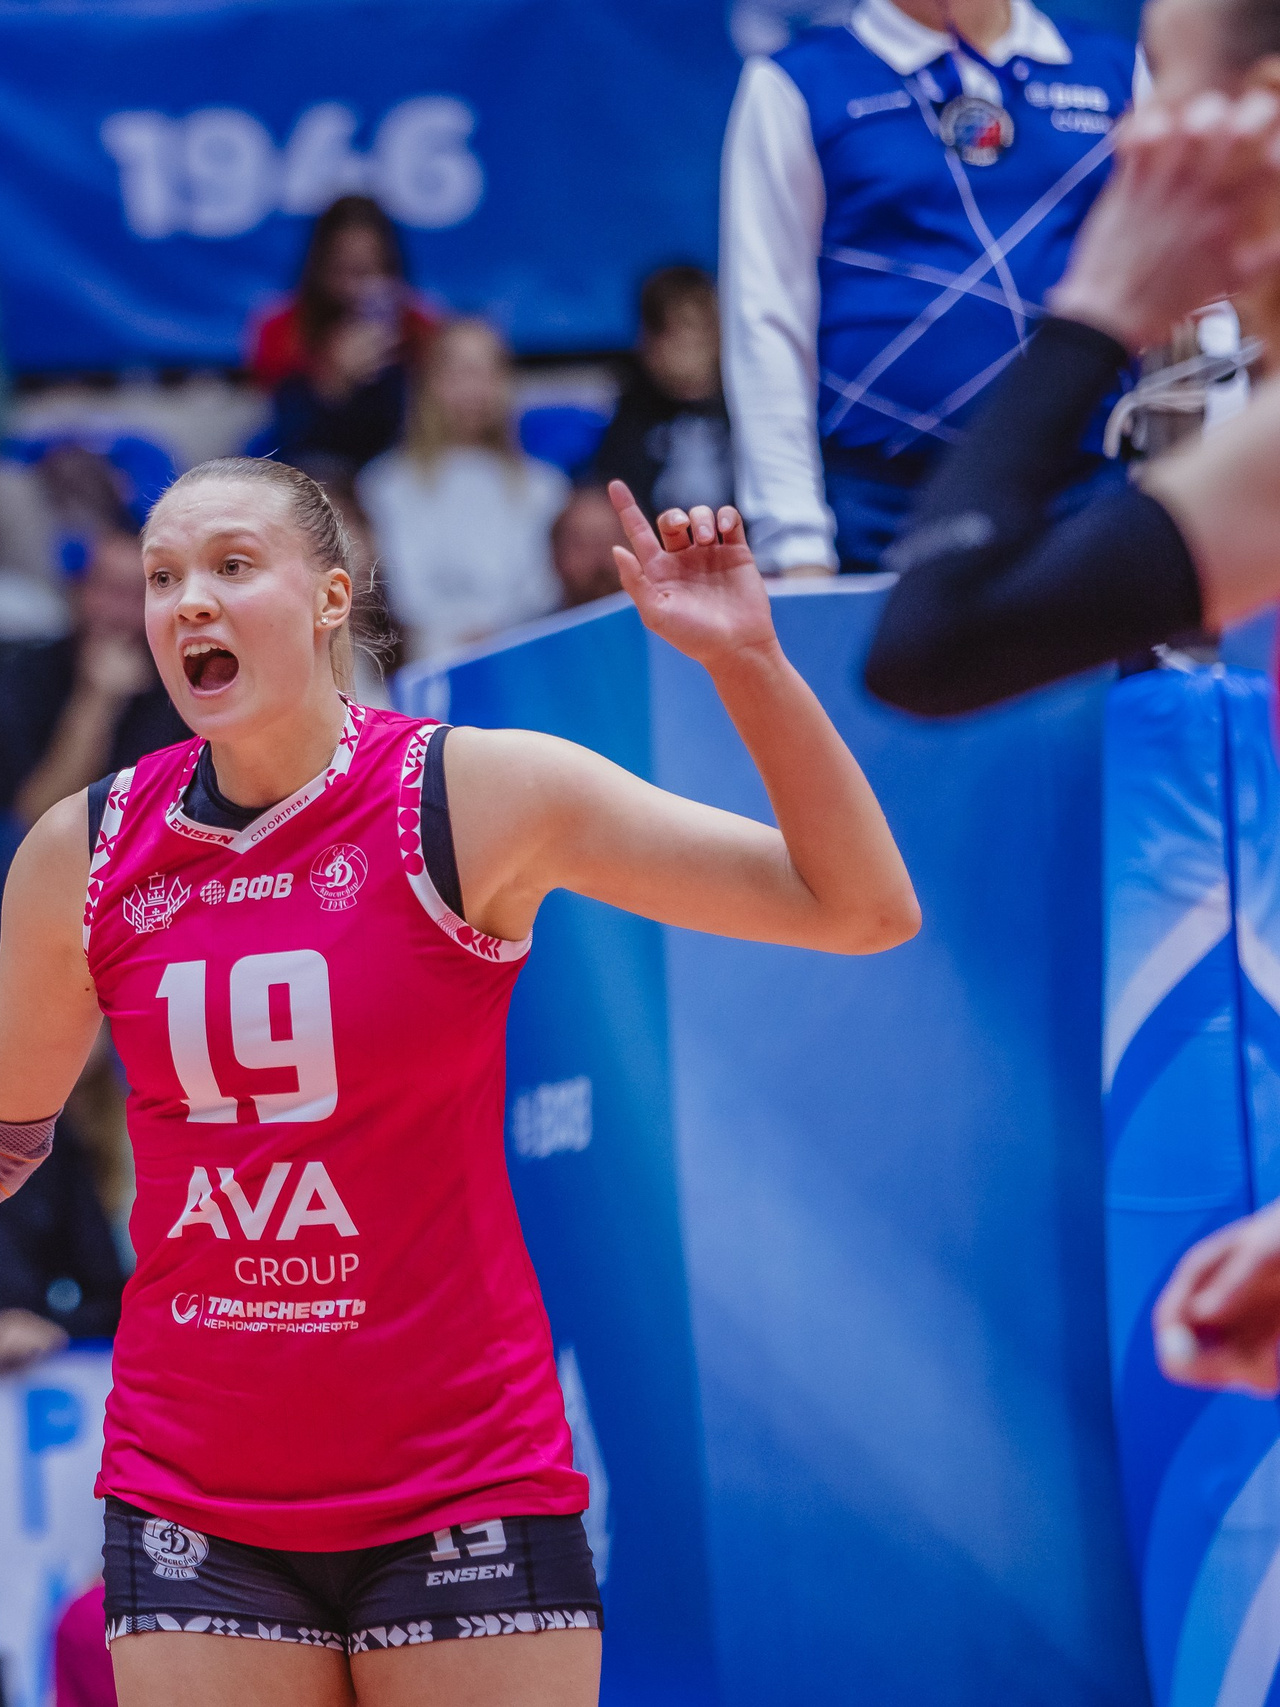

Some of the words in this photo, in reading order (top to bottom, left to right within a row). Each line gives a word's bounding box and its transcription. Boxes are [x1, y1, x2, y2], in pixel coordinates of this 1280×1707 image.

[101, 94, 485, 239] 1946
[169, 818, 234, 846] ENSEN
[227, 873, 295, 904] ВФВ
[155, 949, 338, 1124] 19
[167, 1161, 360, 1241] AVA
[234, 1253, 360, 1286] GROUP
[208, 1296, 367, 1320] ТРАНСНЕФТЬ
[204, 1318, 360, 1333] ЧЕРНОМОРТРАНСНЕФТЬ
[426, 1562, 515, 1587] ENSEN
